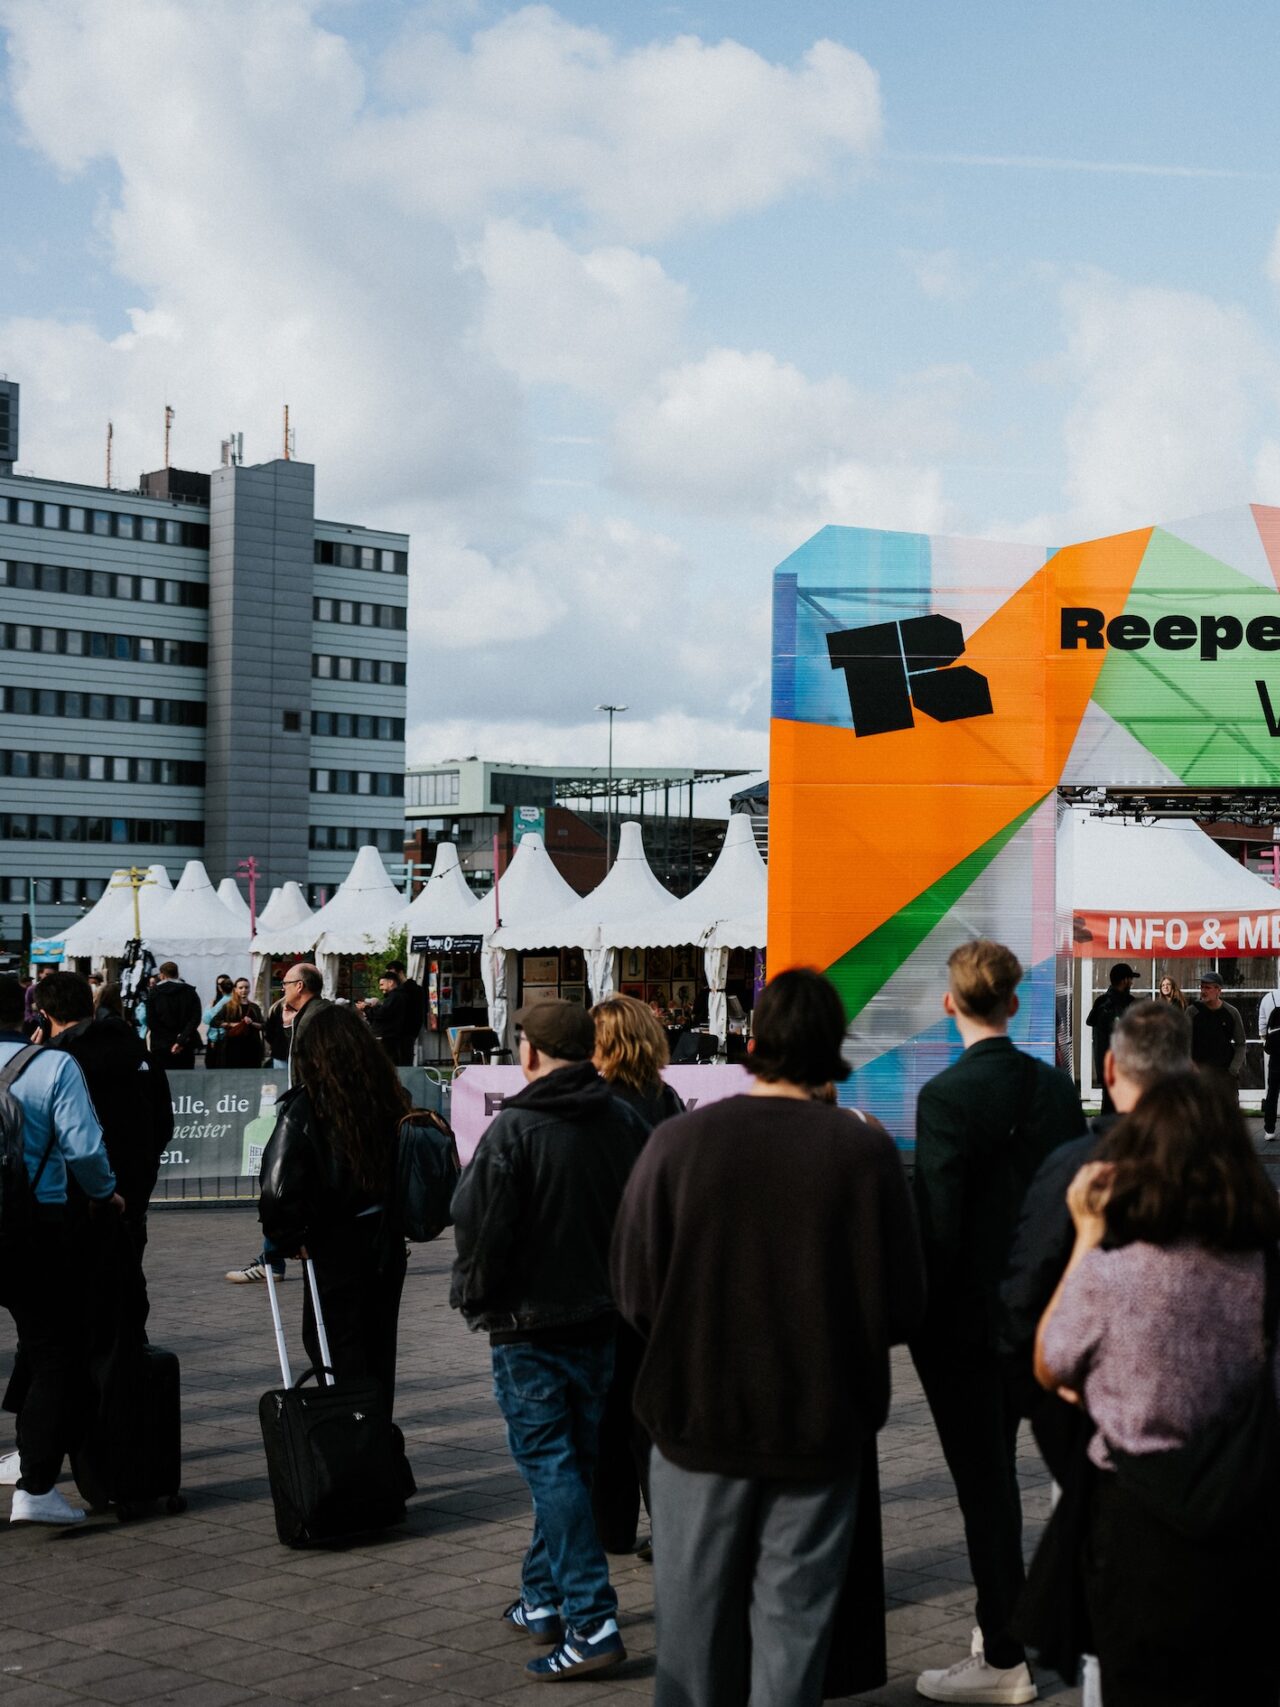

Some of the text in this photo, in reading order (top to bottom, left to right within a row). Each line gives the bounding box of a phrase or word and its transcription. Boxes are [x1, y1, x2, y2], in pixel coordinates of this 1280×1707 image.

[1107, 916, 1189, 951] INFO
[1199, 917, 1226, 951] &
[216, 1094, 250, 1114] die
